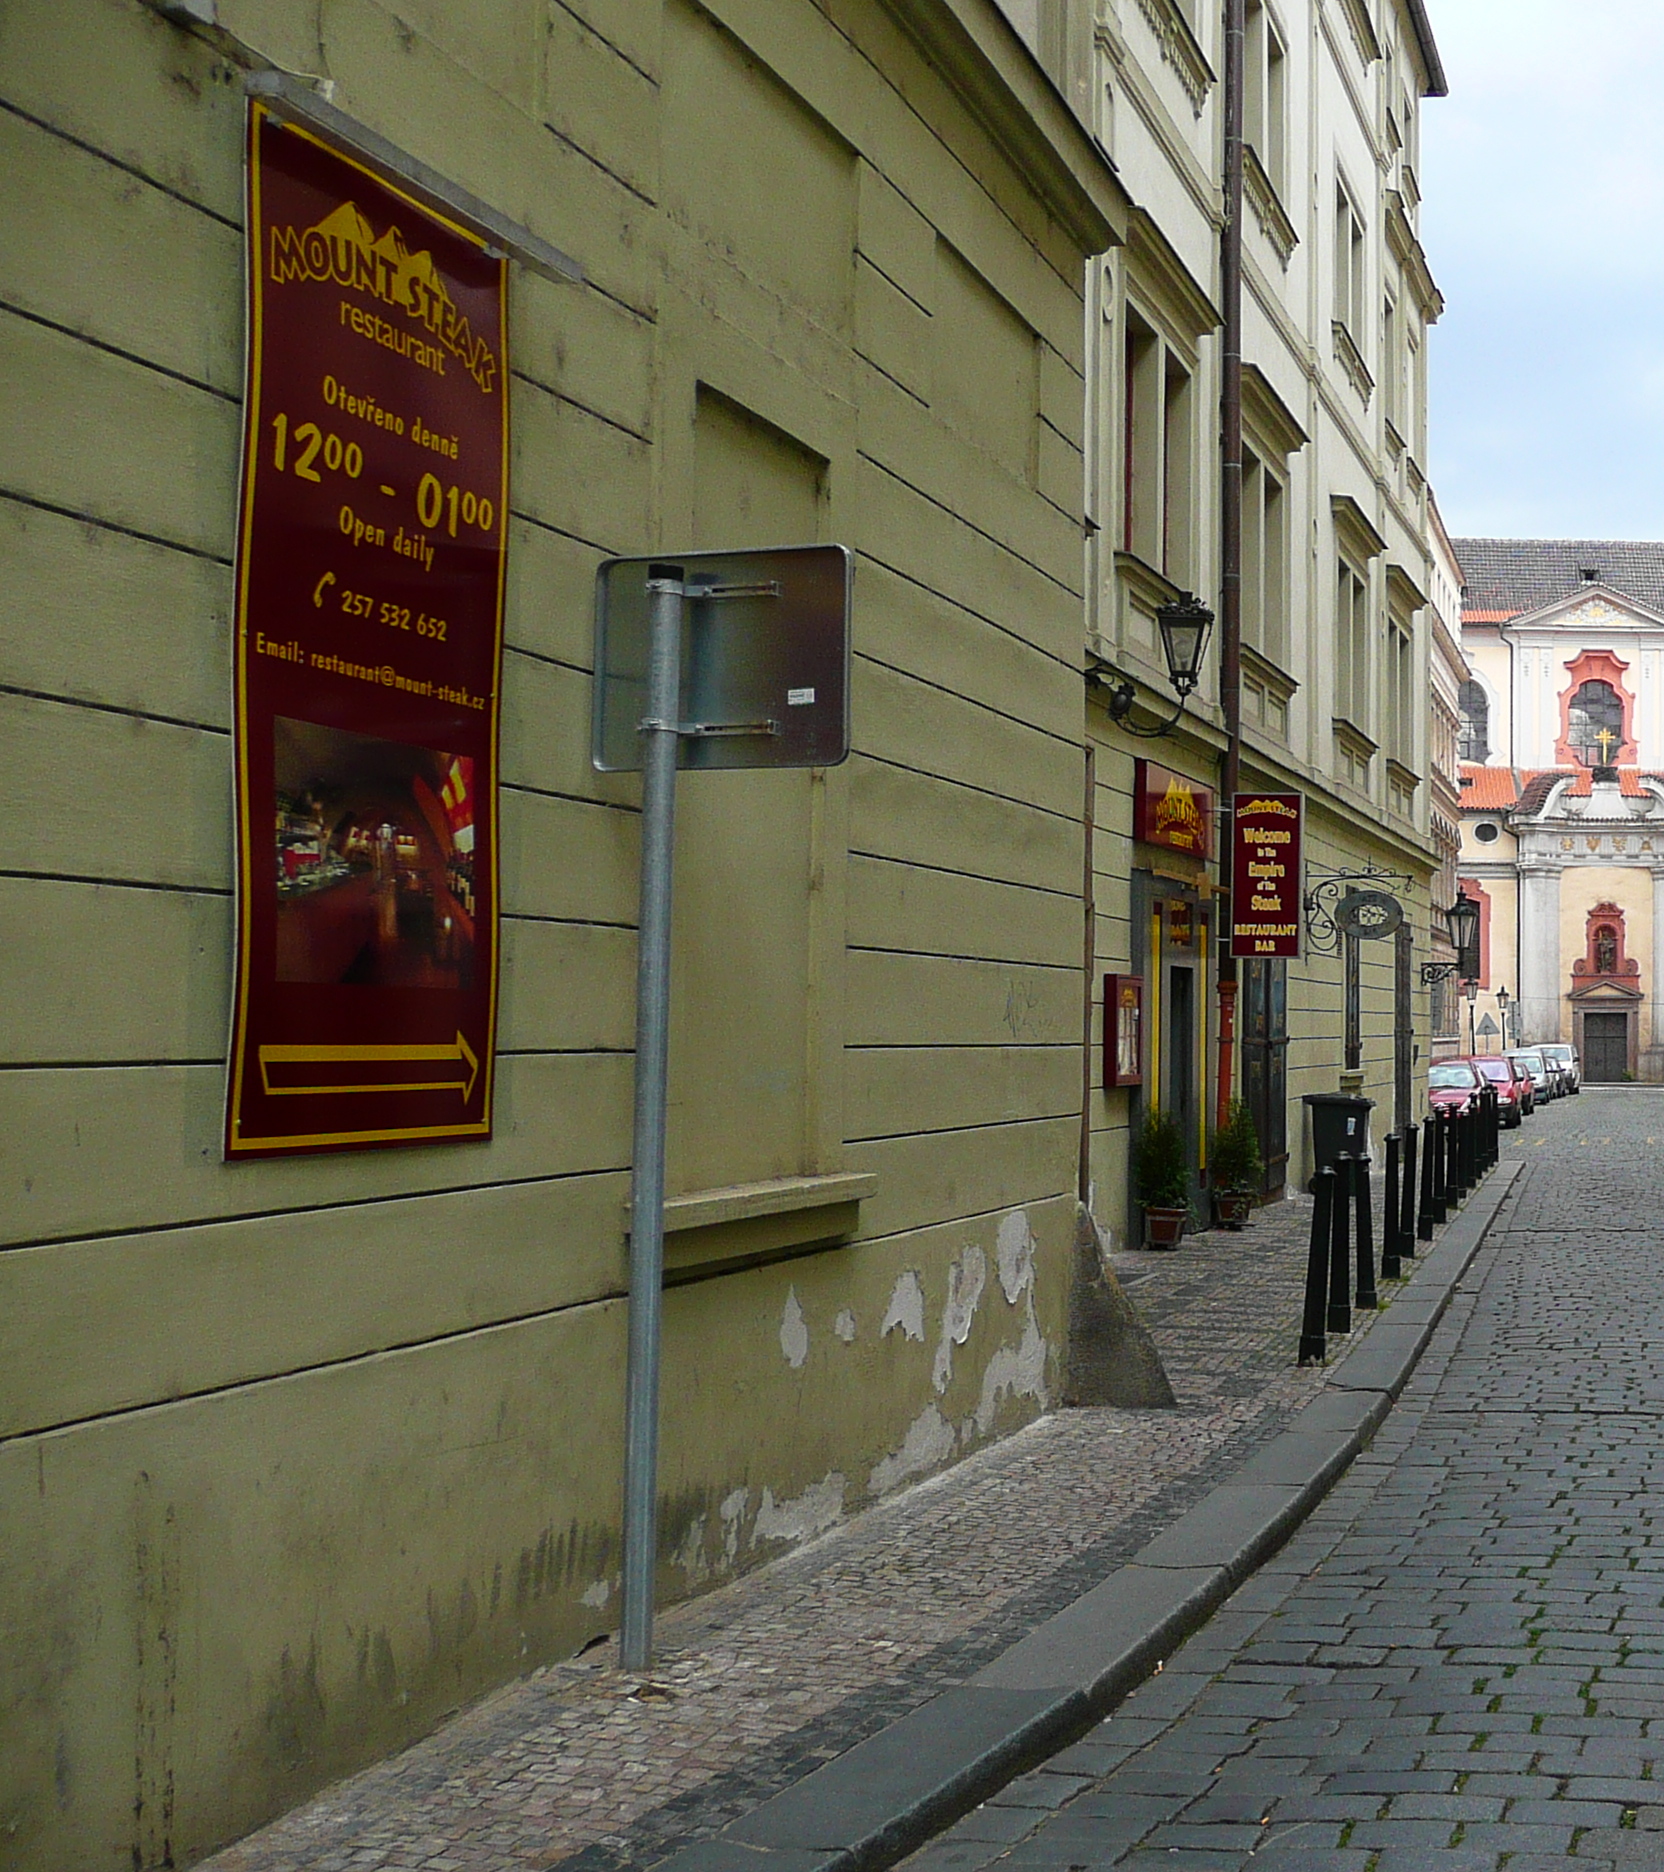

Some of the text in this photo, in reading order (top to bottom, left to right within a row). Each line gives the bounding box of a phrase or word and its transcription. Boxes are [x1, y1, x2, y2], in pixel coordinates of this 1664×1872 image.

[271, 225, 496, 393] MOUNT STEAK
[340, 300, 446, 375] restaurant
[323, 375, 459, 460] Otevřeno denně
[339, 505, 434, 572] Open daily
[341, 590, 448, 642] 257 532 652
[256, 631, 486, 711] Email: restaurant@mount-steak.cz
[1243, 827, 1291, 844] Welcome
[1248, 861, 1285, 880] Empire
[1251, 894, 1282, 911] Steak
[1234, 924, 1298, 936] RESTAURANT
[1255, 940, 1276, 952] BAR
